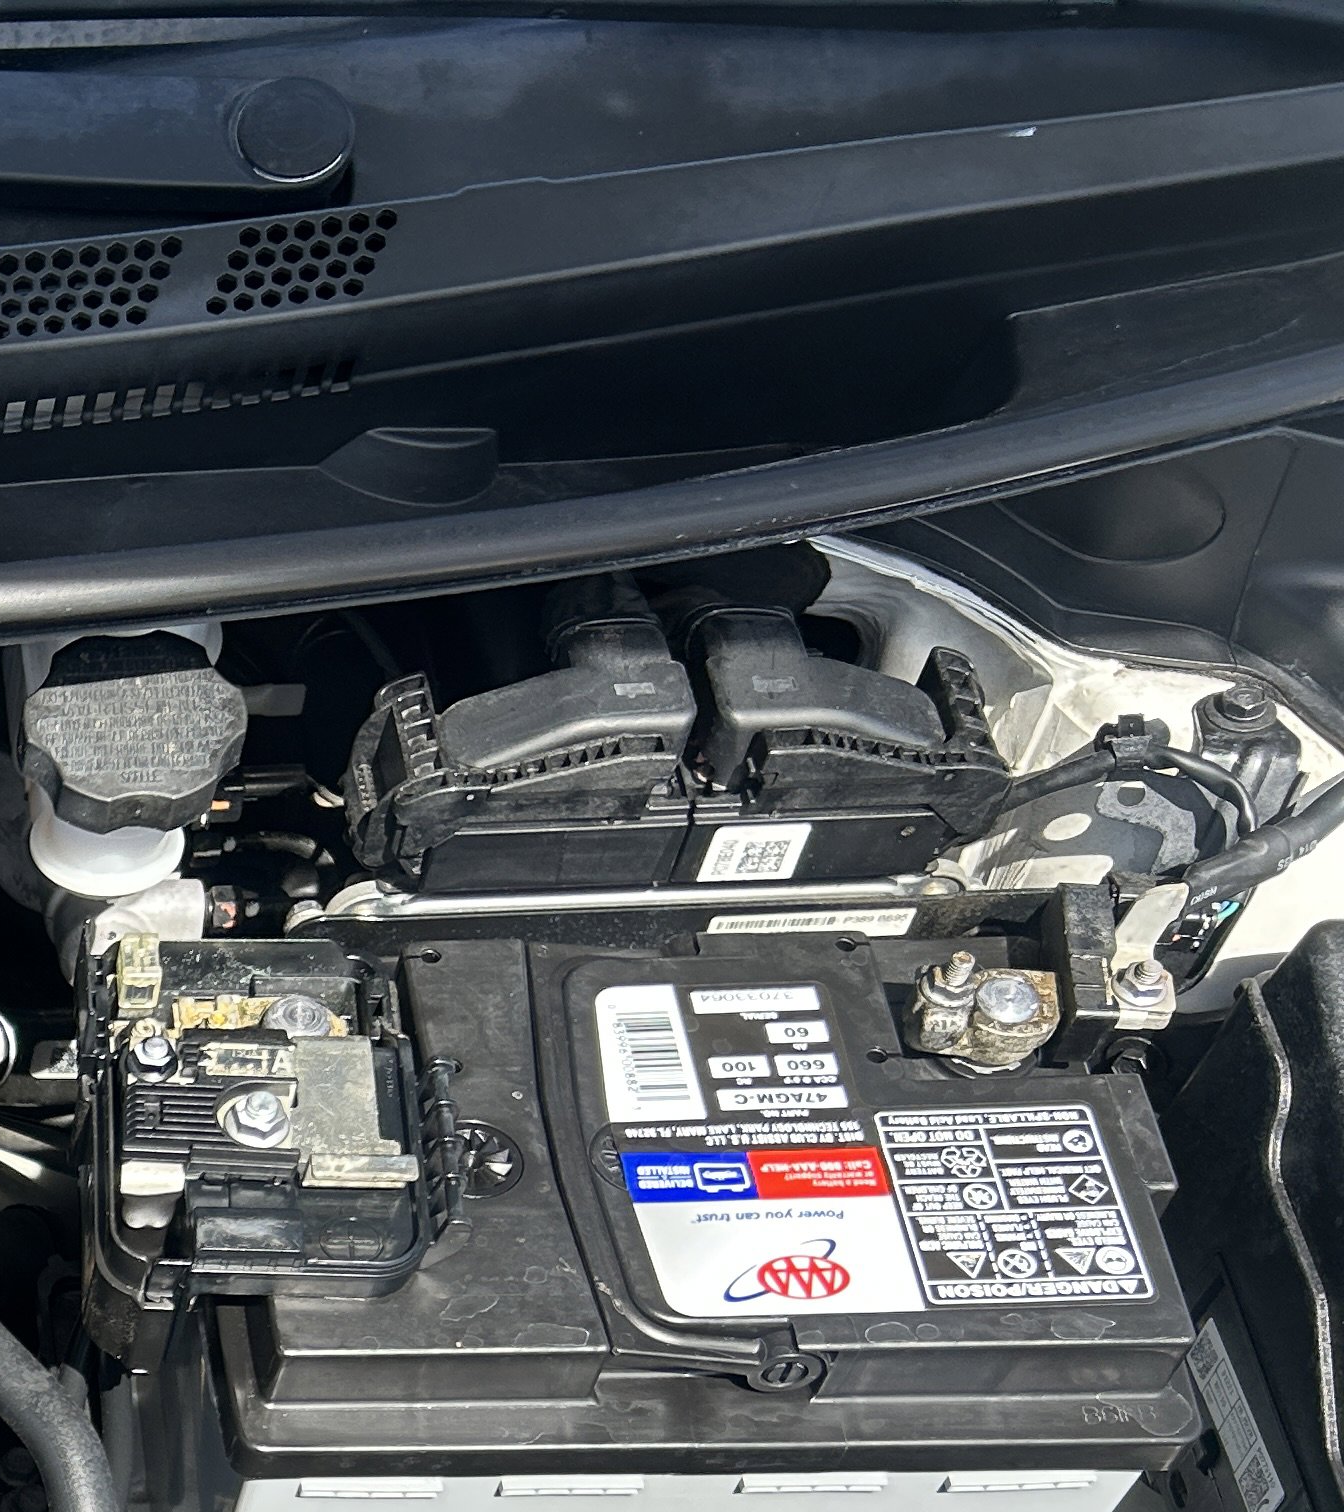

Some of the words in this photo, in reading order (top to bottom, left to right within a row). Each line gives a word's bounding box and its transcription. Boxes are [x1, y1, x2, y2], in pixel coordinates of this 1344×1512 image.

[783, 1027, 809, 1038] 60
[721, 1061, 756, 1072] 100
[787, 1059, 825, 1071] 660
[733, 1092, 828, 1105] 47AGM-C
[735, 1211, 760, 1221] can
[765, 1208, 793, 1220] you
[797, 1209, 844, 1220] Power
[762, 1255, 846, 1299] AAA
[937, 1279, 1121, 1299] DANGER/POISON
